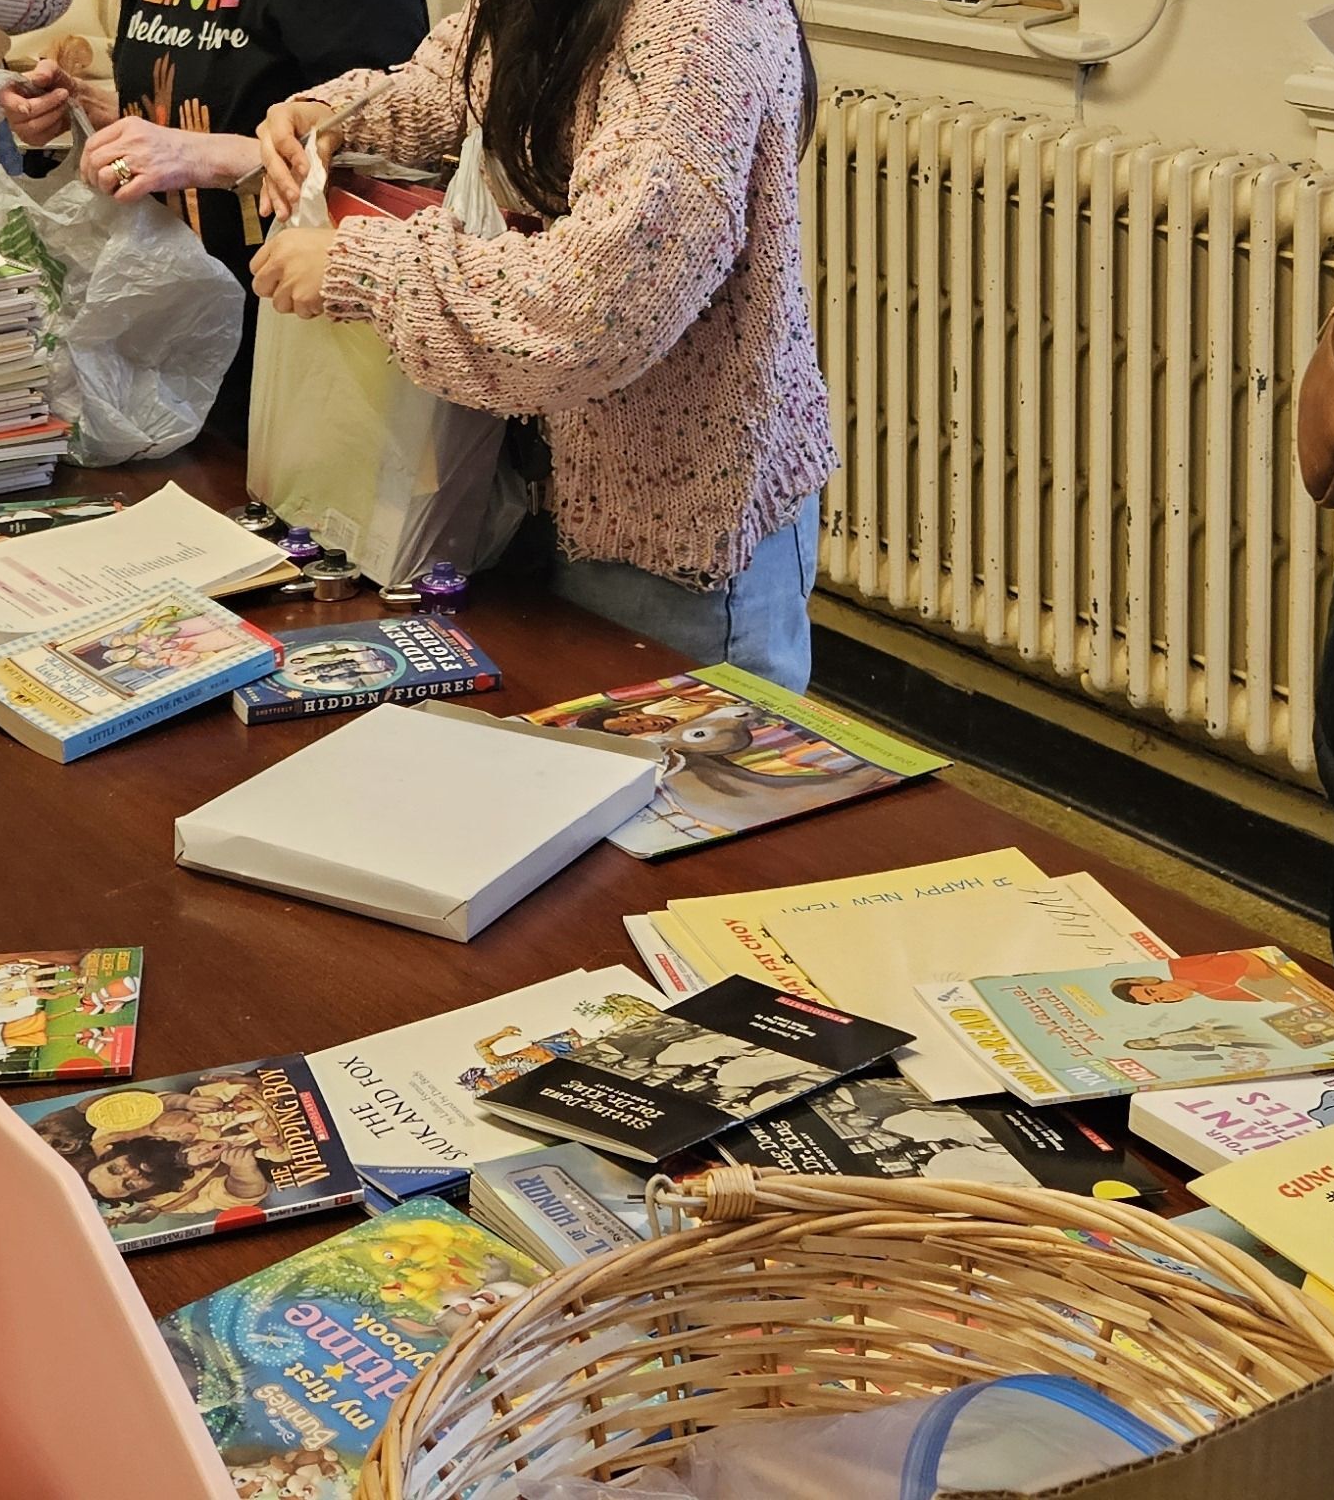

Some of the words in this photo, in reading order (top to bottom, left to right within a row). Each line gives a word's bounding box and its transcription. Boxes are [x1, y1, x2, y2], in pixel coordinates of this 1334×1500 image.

[379, 624, 437, 673] HIDDEN
[403, 620, 463, 672] FIGURES
[304, 692, 379, 713] HIDDEN
[394, 678, 474, 700] FIGURES
[88, 728, 117, 744] LITTLE
[119, 716, 142, 731] TOWN
[142, 711, 155, 722] ON
[853, 891, 903, 908] NEW
[914, 876, 983, 898] HAPPY
[723, 917, 767, 952] CHOY
[1132, 933, 1167, 959] ASTIC
[752, 949, 787, 979] FAT
[1000, 986, 1093, 1059] Lin-Manuel
[1037, 988, 1105, 1044] Miranda
[257, 1068, 297, 1101] BOY
[338, 1056, 383, 1087] FOX
[1066, 1066, 1108, 1087] YOU
[1112, 1059, 1155, 1081] MEET
[539, 1088, 584, 1107] Down
[560, 1080, 608, 1100] King
[608, 1095, 635, 1109] Dr.
[349, 1102, 395, 1139] THE
[375, 1089, 424, 1124] AND
[581, 1100, 652, 1130] Sitting
[635, 1105, 665, 1118] for
[272, 1099, 331, 1189] WHIPPING
[411, 1124, 468, 1161] SAUK
[769, 1120, 805, 1150] King
[1205, 1128, 1250, 1156] YOUR
[799, 1150, 824, 1170] Dr.
[271, 1165, 297, 1193] THE
[514, 1174, 579, 1228] HONOR
[122, 1240, 140, 1250] THE
[141, 1231, 184, 1246] WHIPPING
[184, 1226, 202, 1238] BOY
[567, 1230, 587, 1241] OF
[600, 1223, 623, 1244] Ryan
[284, 1304, 414, 1401] dtime
[352, 1313, 435, 1371] ybook
[283, 1362, 338, 1404] first
[252, 1383, 339, 1450] Bunnies
[331, 1399, 376, 1430] my
